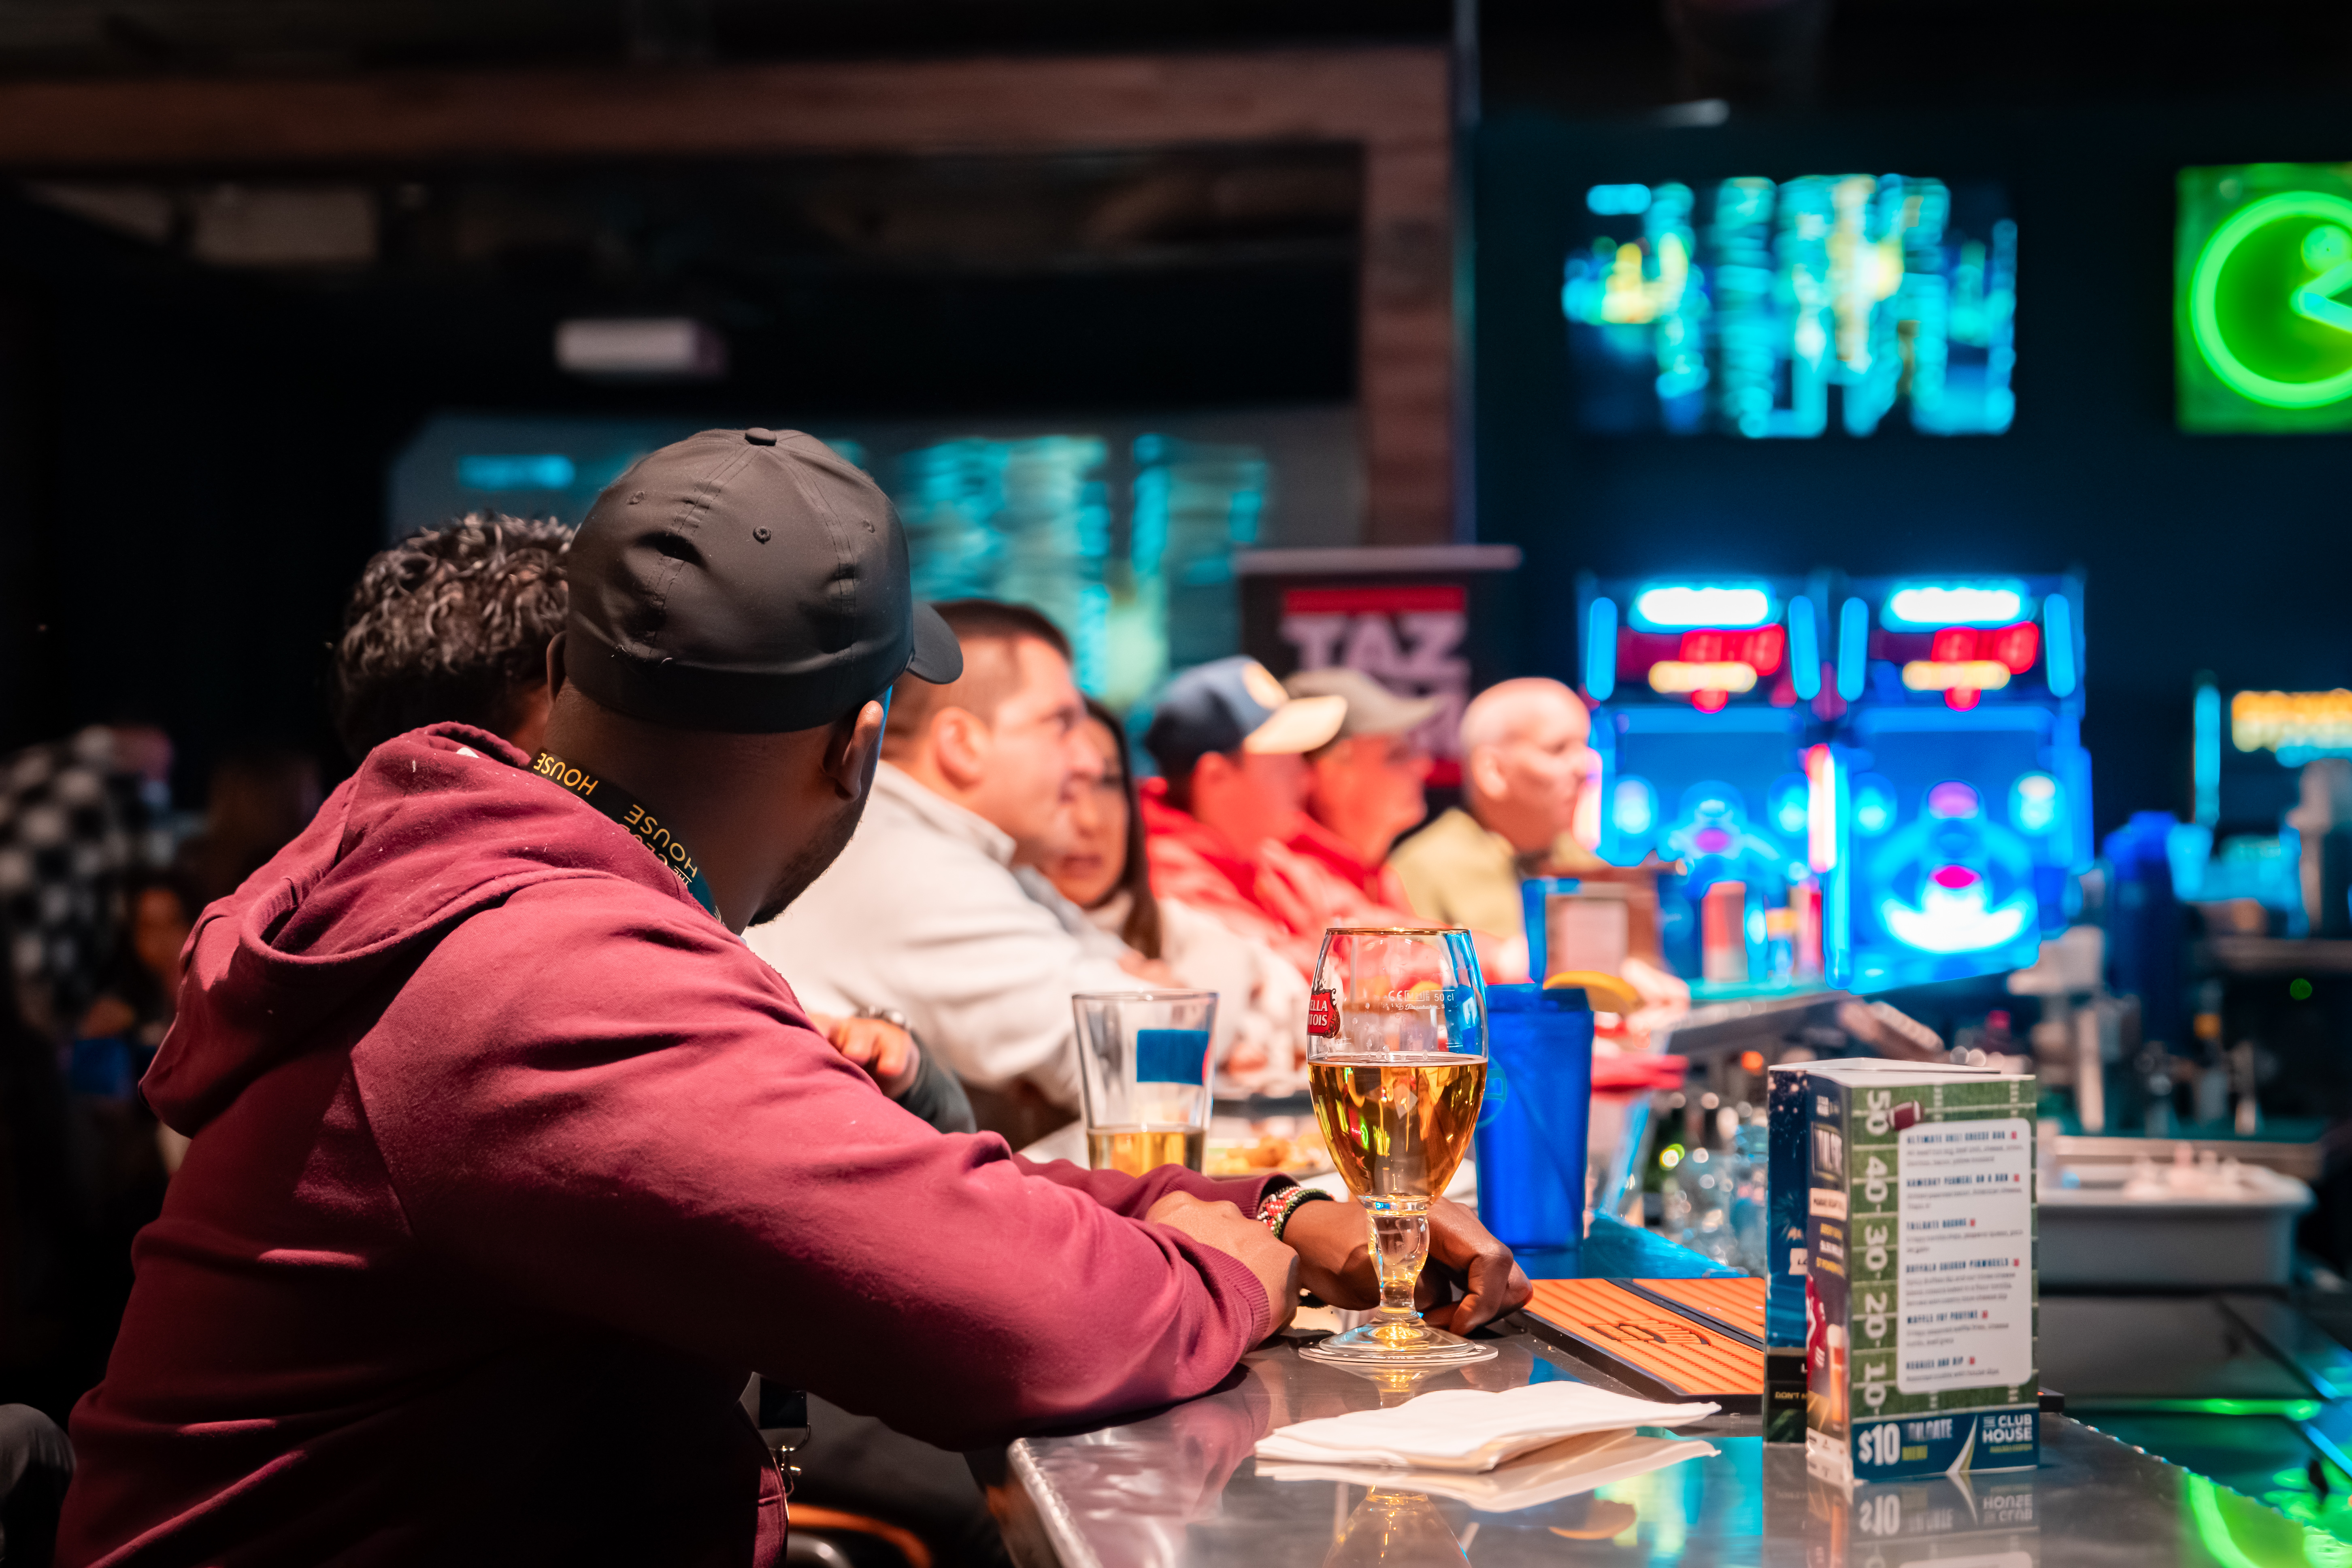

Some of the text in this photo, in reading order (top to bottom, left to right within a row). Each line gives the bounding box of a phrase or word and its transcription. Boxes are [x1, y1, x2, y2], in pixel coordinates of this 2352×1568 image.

[534, 753, 598, 795] HOUSE
[624, 804, 697, 878] HOUSE
[1434, 993, 1454, 1002] 50 cl
[1309, 1014, 1328, 1026] TOIS
[1865, 1156, 1888, 1202] 40
[1865, 1225, 1888, 1271] 30
[1865, 1292, 1888, 1339] 20
[1865, 1362, 1887, 1407] 10
[1982, 1426, 2033, 1444] HOUSE
[1998, 1413, 2033, 1428] CLUB
[1858, 1423, 1901, 1466] $10
